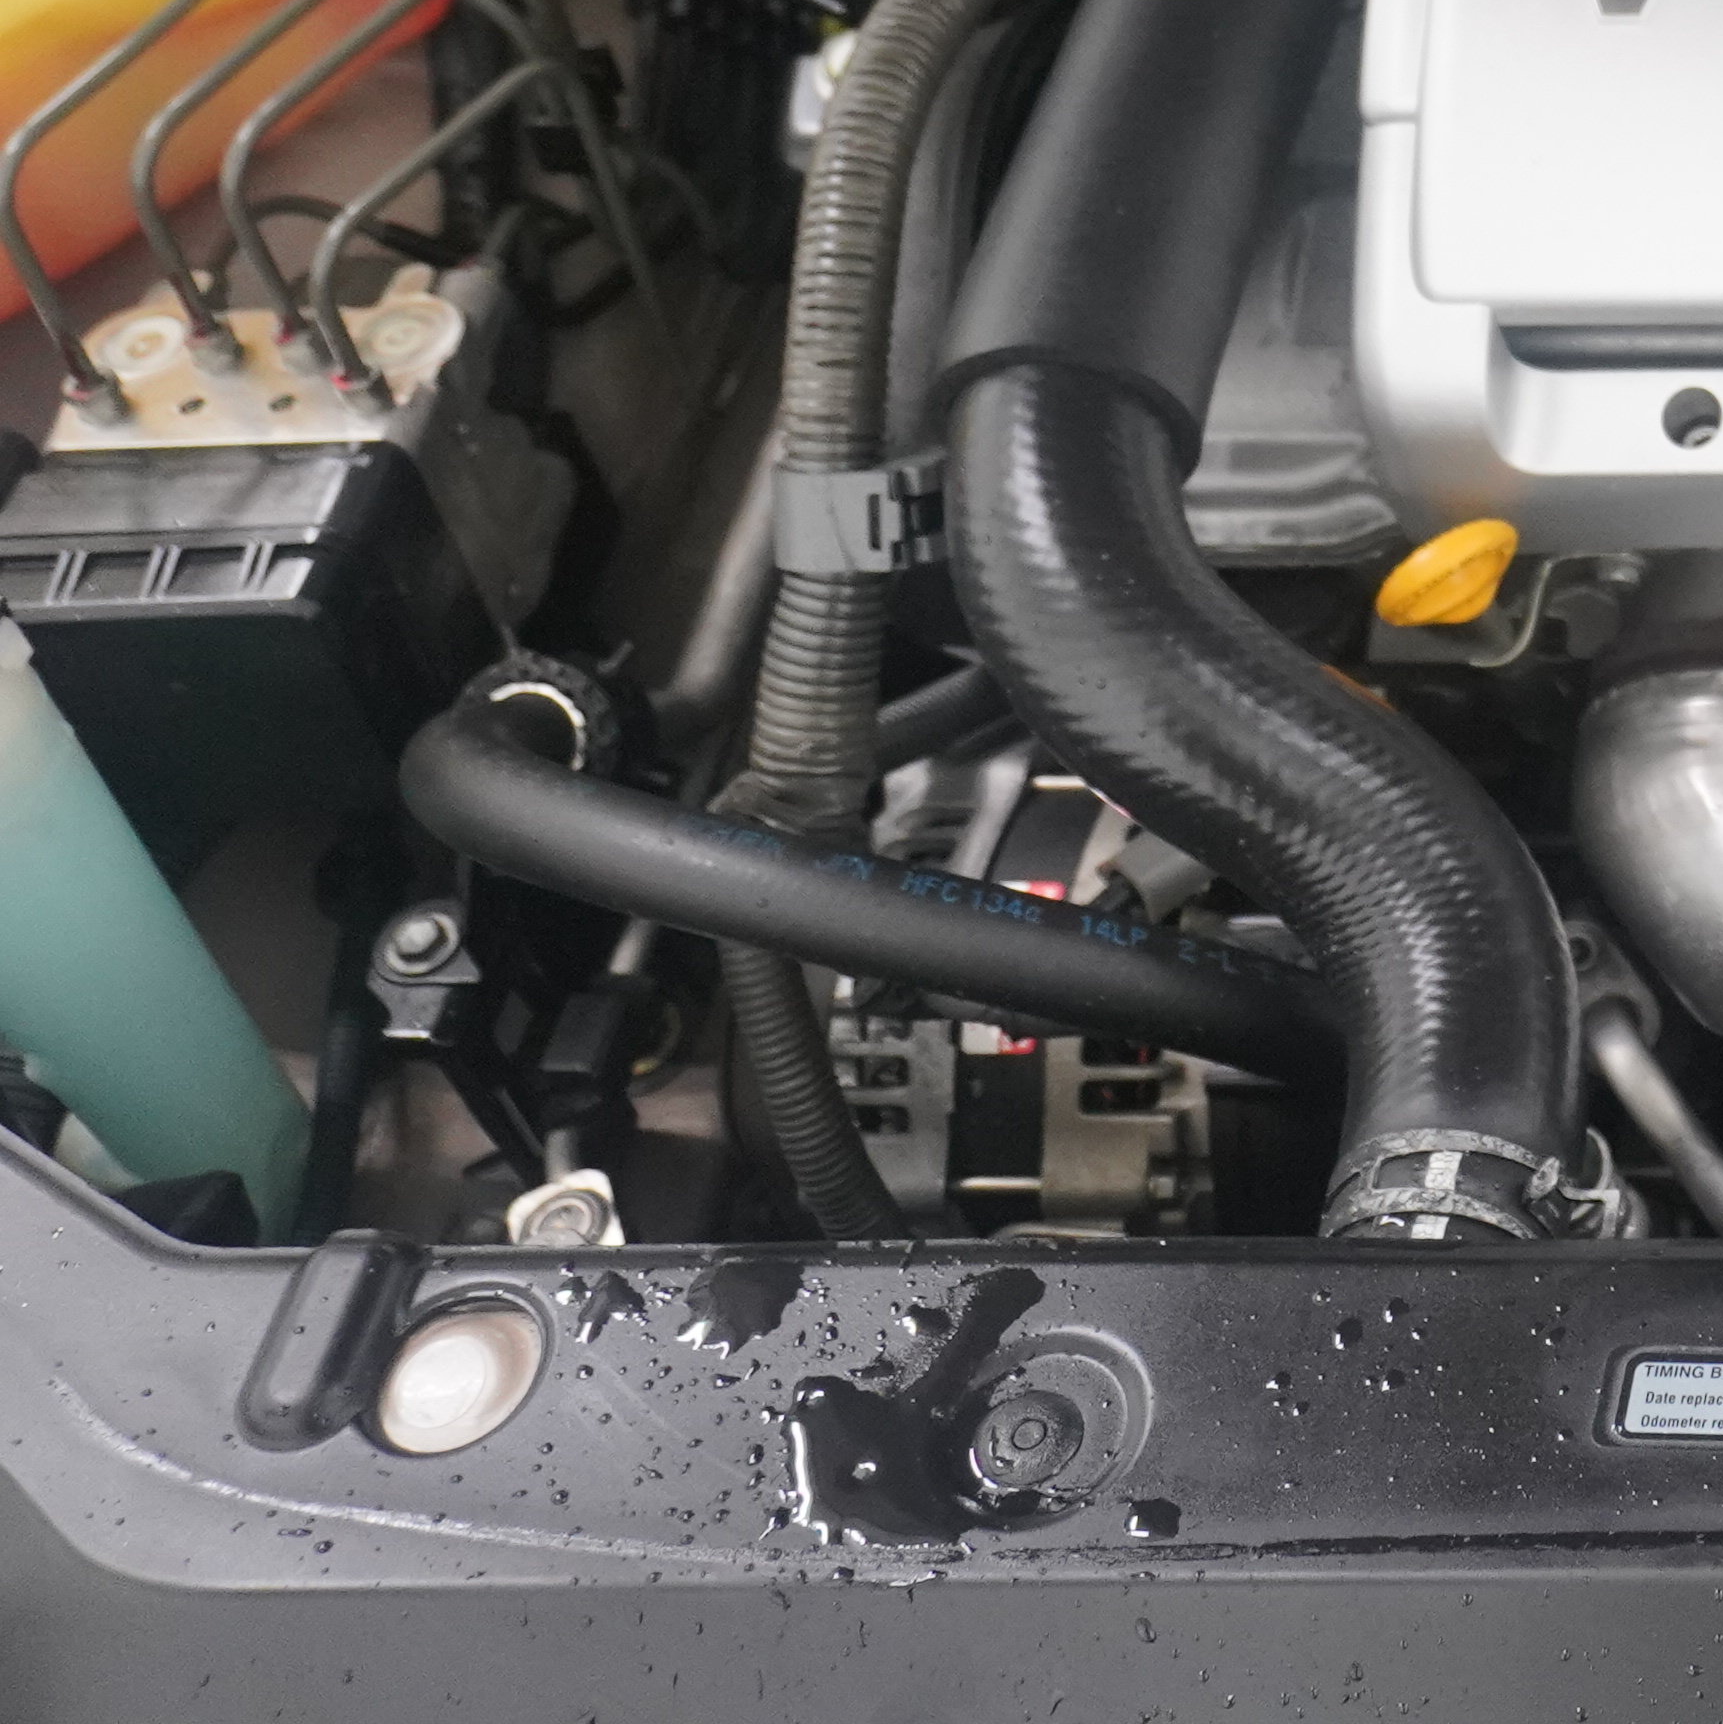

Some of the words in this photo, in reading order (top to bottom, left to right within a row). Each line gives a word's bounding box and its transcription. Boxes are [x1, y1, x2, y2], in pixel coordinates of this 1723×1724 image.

[1645, 1364, 1704, 1379] TIMING
[1645, 1390, 1676, 1405] Date
[1640, 1414, 1708, 1429] Odometer
